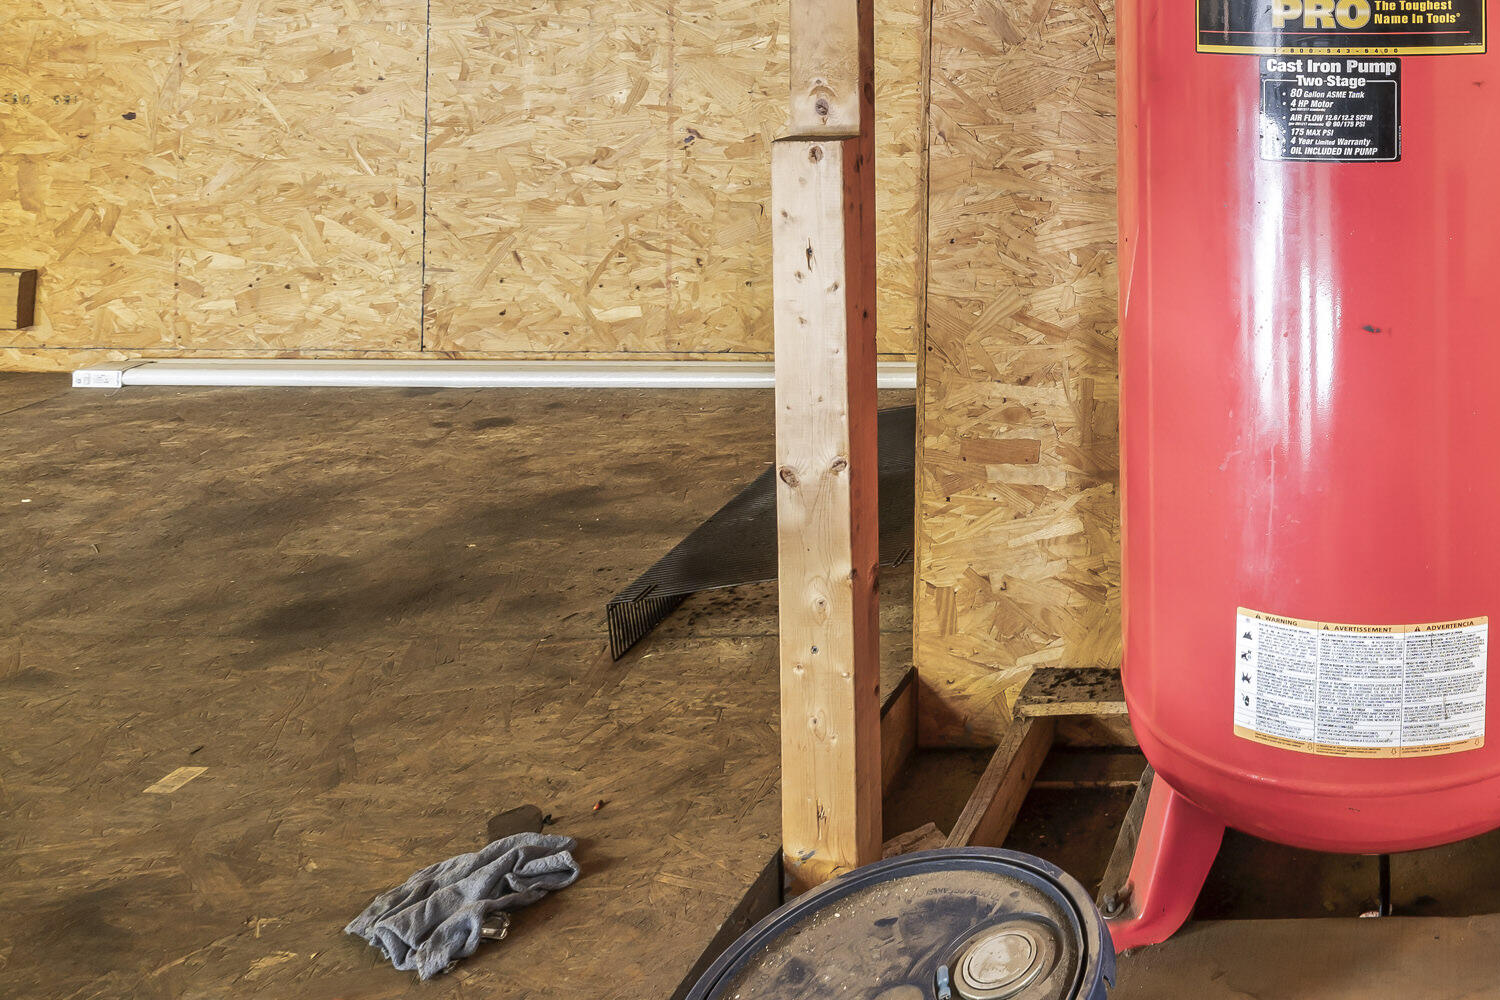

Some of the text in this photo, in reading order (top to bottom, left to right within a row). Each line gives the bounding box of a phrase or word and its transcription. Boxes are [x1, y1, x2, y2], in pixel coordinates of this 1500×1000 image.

[1374, 0, 1453, 13] The Toughest
[1374, 13, 1409, 25] Name
[1412, 13, 1423, 25] In
[1266, 58, 1397, 76] Cast Iron Pump
[1290, 88, 1303, 98] 80
[1326, 91, 1347, 99] ASME
[1348, 91, 1365, 99] Tank
[1290, 98, 1334, 108] 4 HP Motor
[1304, 114, 1324, 122] FLOW
[1291, 128, 1304, 136] 175
[1337, 138, 1371, 147] Warranty
[1290, 147, 1378, 156] OIL INCLUDED IN PUMP
[1265, 615, 1298, 626] WARNING
[1426, 620, 1474, 631] ADVERTENCIA
[1335, 625, 1392, 633] AVERTISSEMENT
